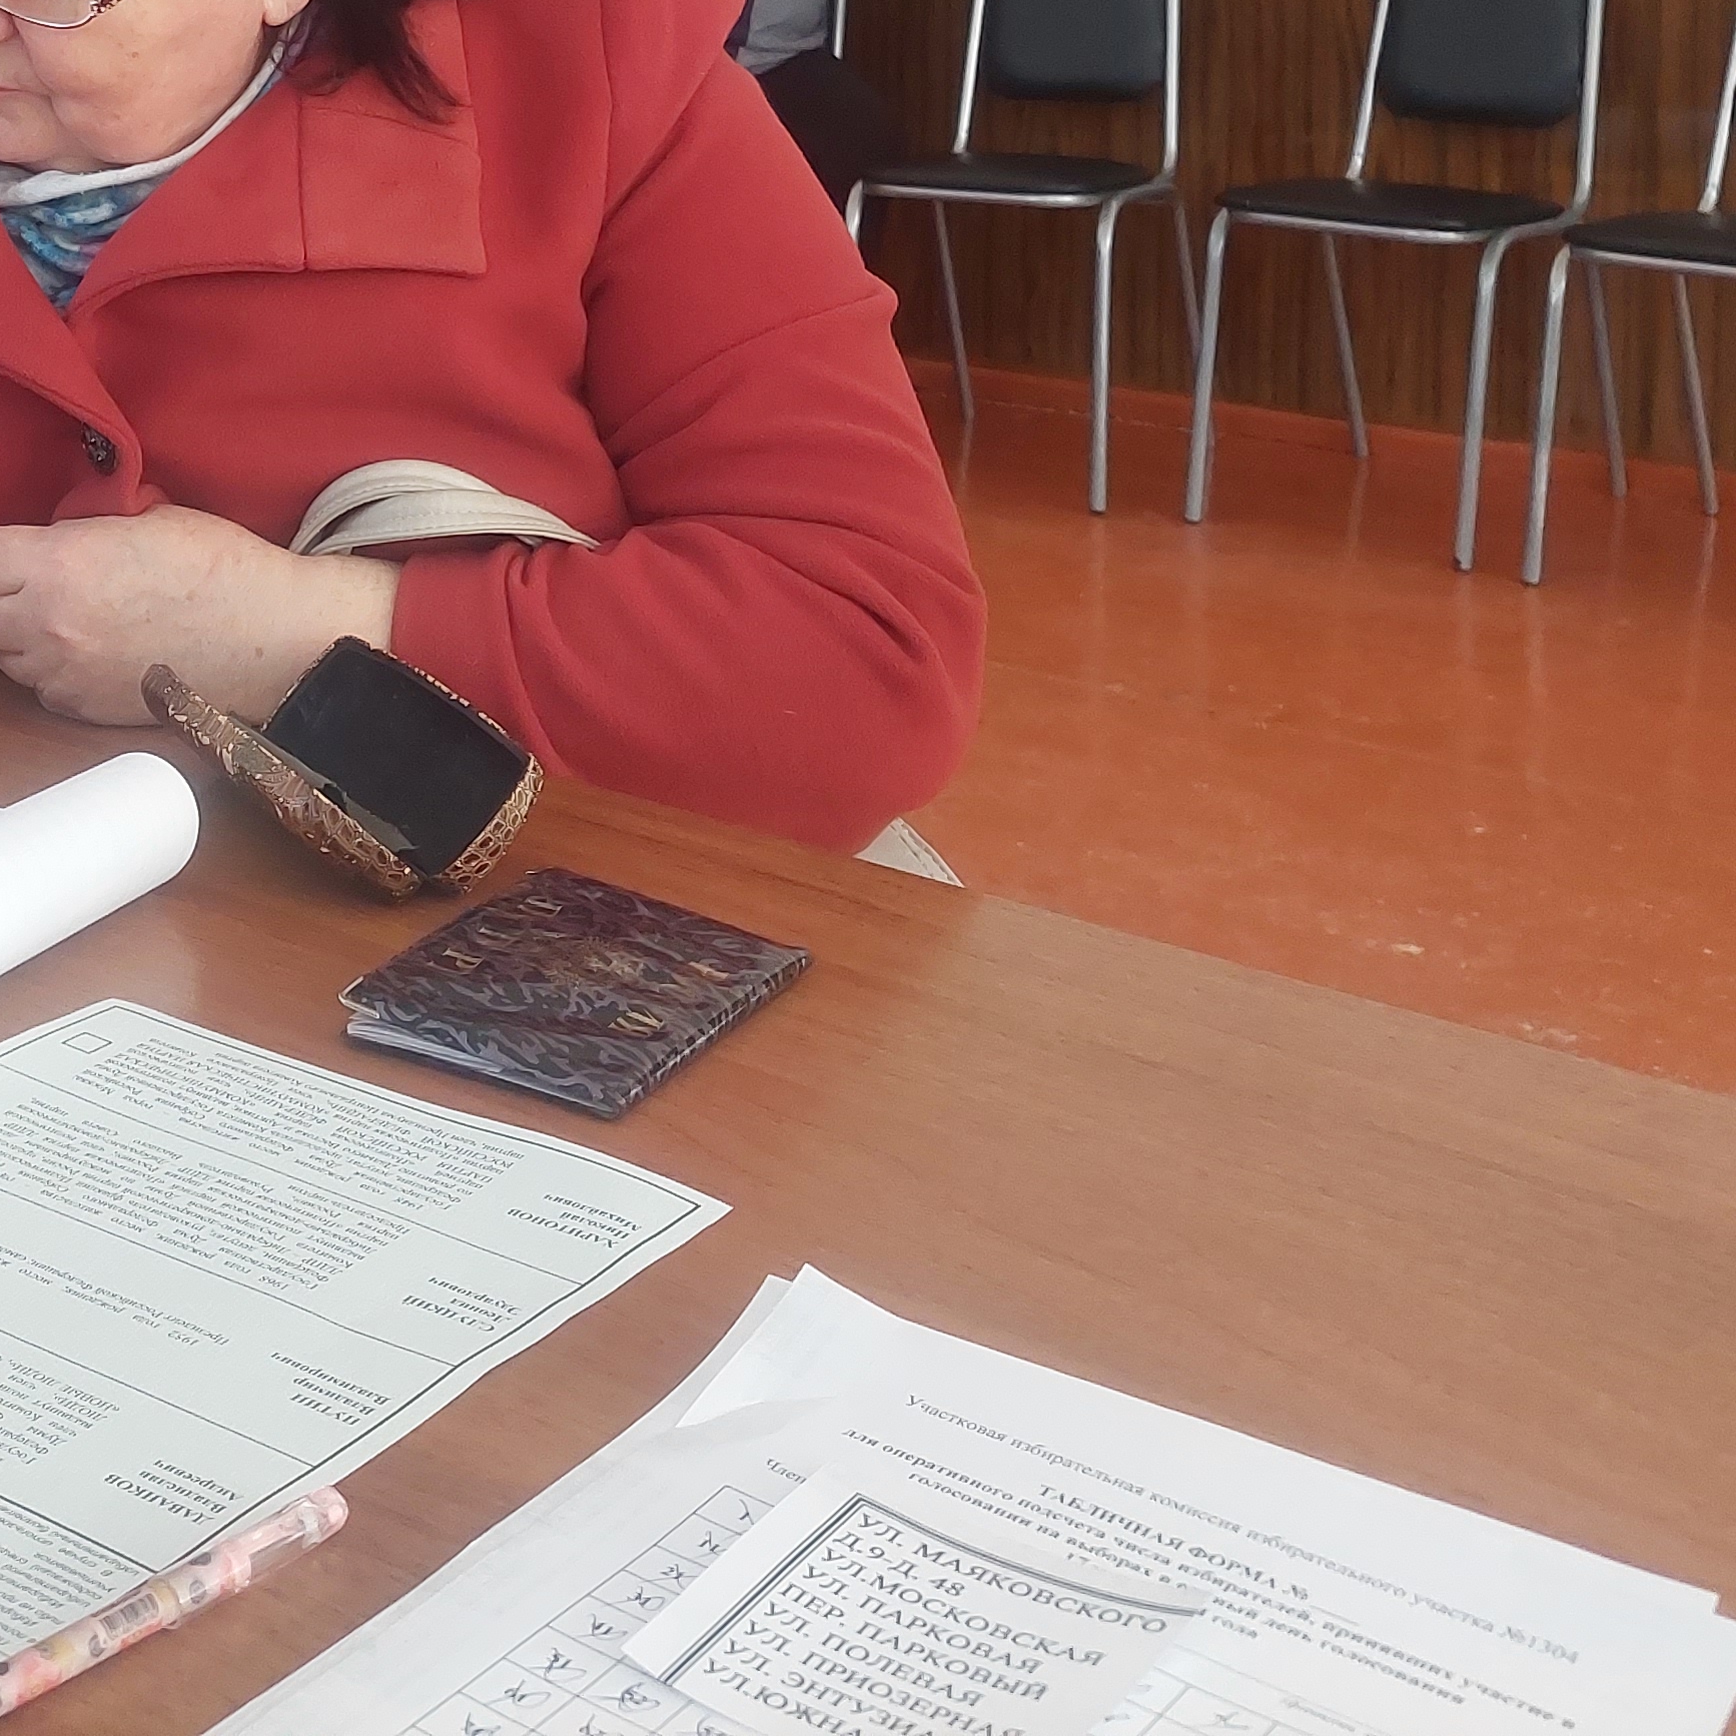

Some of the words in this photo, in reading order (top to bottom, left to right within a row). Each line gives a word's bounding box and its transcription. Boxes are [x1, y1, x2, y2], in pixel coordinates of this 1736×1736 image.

[506, 1207, 620, 1250] ХАРИТОНОВ
[542, 1193, 644, 1233] Михайлович
[557, 1210, 631, 1241] Николай
[400, 1294, 496, 1333] СЛУЦКИЙ
[426, 1275, 523, 1317] Эдуардович
[448, 1296, 513, 1325] Леонид
[269, 1351, 393, 1407] Владимирович
[291, 1376, 377, 1417] Владимир
[288, 1392, 362, 1427] ПУТИН
[151, 1458, 245, 1503] Андреевич
[904, 1393, 1009, 1443] Участковая
[1008, 1437, 1147, 1498] избирательная
[1148, 1490, 1244, 1535] комиссия
[103, 1473, 216, 1527] ДАВАНКОВ
[137, 1469, 229, 1515] Владислав
[1037, 1483, 1187, 1552] ТАБЛИЧНАЯ
[1186, 1545, 1276, 1591] ФОРМА
[1280, 1583, 1310, 1602] №
[856, 1511, 906, 1549] УЛ.
[910, 1540, 1169, 1634] МАЯКОВСКОГО
[927, 1577, 967, 1598] 48
[741, 1618, 793, 1658] УЛ.
[800, 1561, 851, 1602] УЛ.
[854, 1593, 1045, 1675] ПАРКОВАЯ
[722, 1638, 773, 1678] УЛ.
[762, 1600, 813, 1639] УЛ.
[820, 1630, 985, 1708] ПОЛЕВАЯ
[776, 1580, 847, 1629] ПЕР.
[854, 1619, 1048, 1702] ПАРКОВЫЙ
